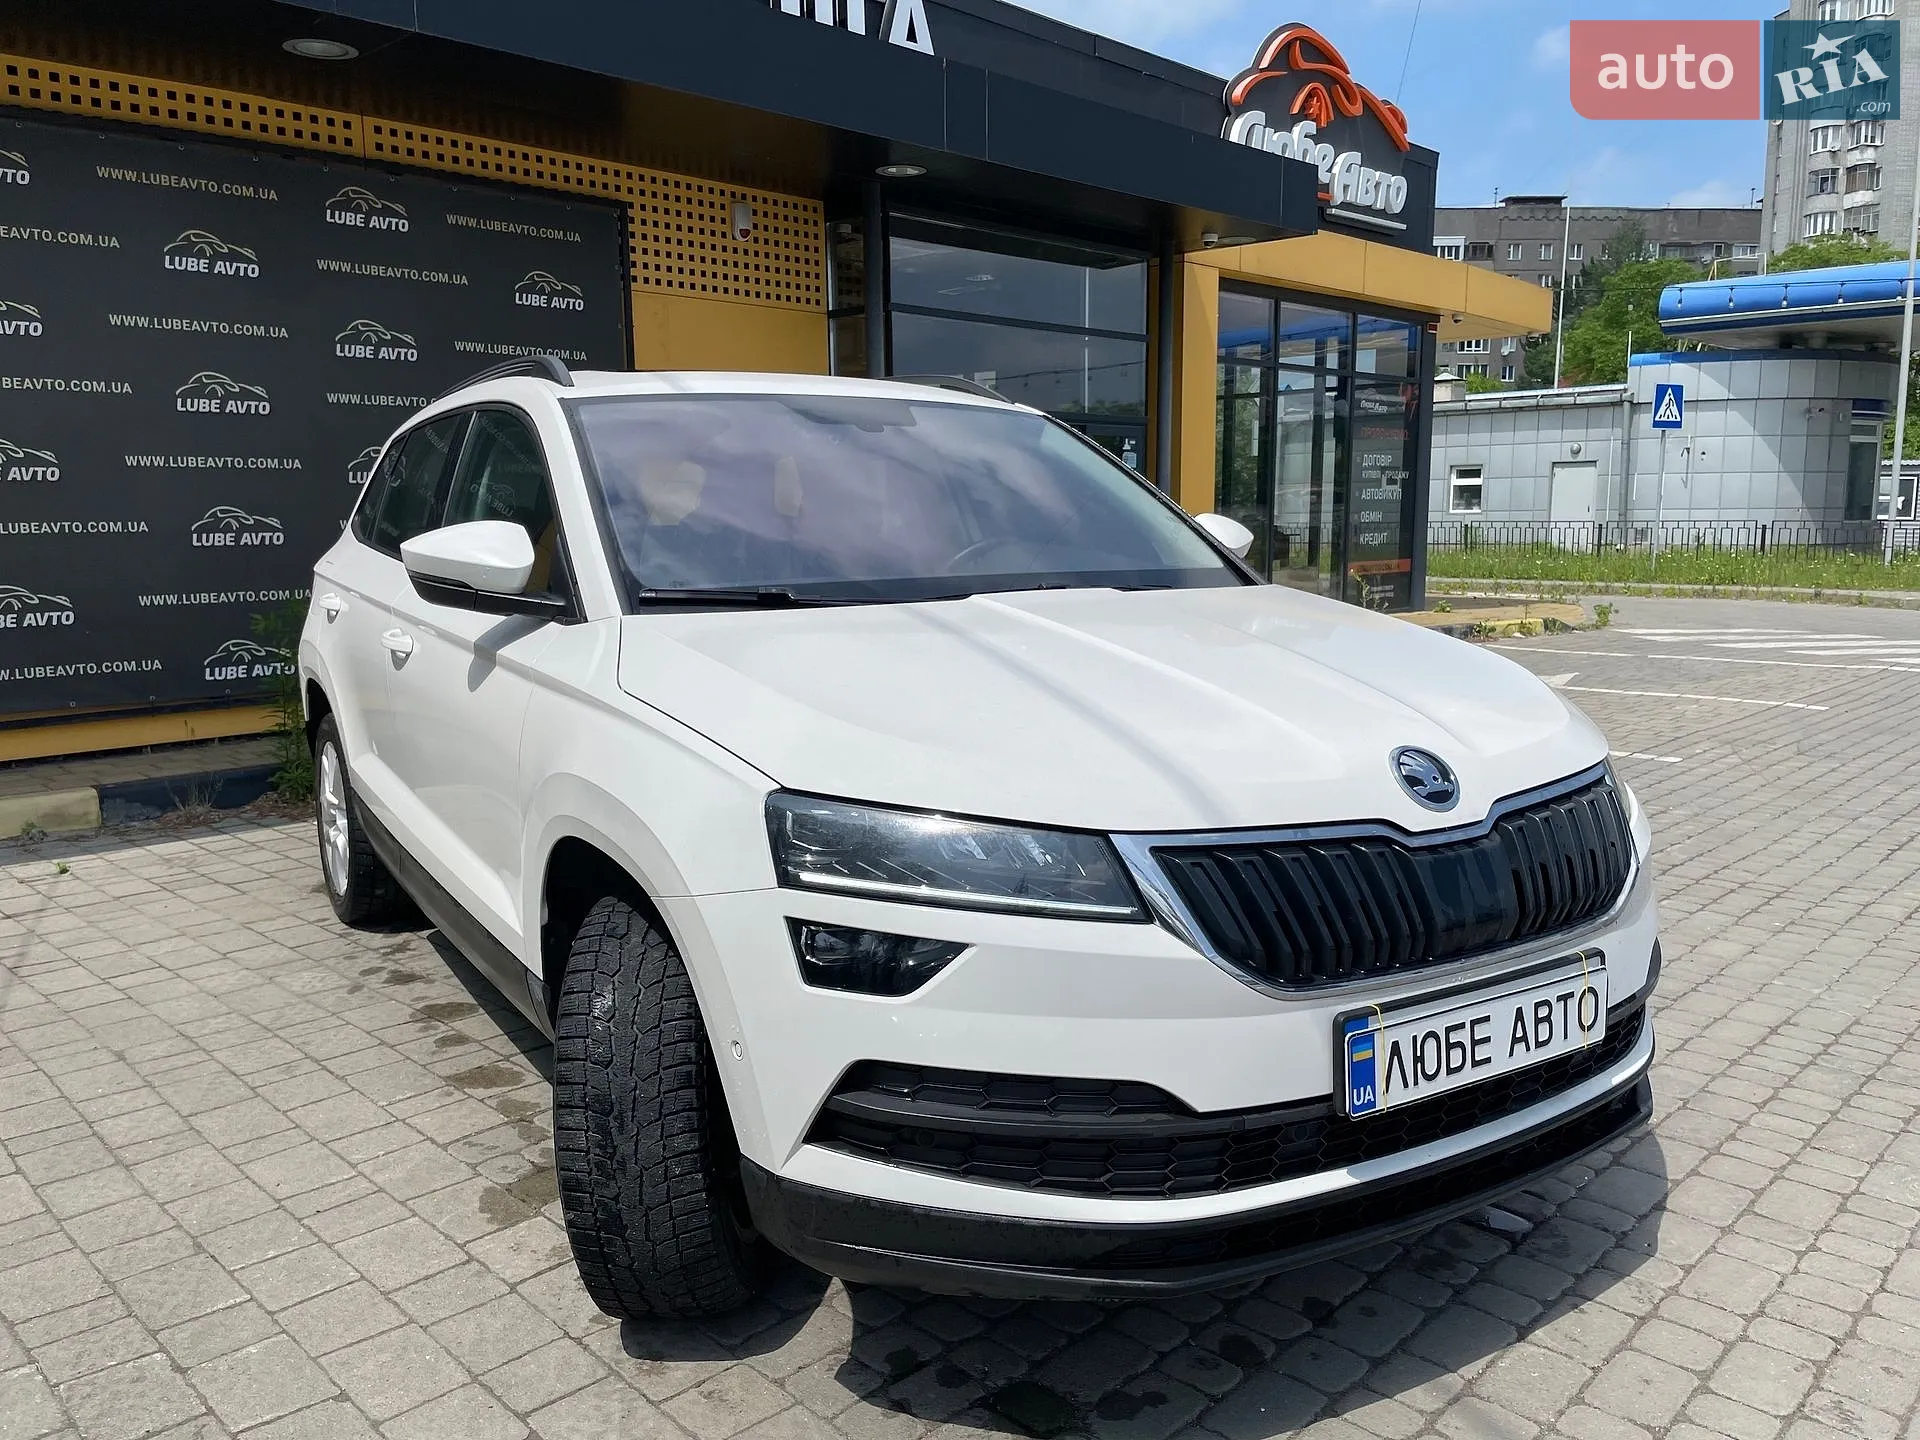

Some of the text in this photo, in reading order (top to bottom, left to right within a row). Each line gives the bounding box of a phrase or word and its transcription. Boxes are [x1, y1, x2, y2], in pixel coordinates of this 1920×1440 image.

[96, 165, 278, 200] WWW.LUBEAVTO.COM.UA
[326, 208, 409, 232] LUBE AVTO
[446, 214, 582, 243] WWW.LUBEAVTO.COM.UA
[164, 255, 260, 278] LUBE AVTO
[316, 259, 469, 286] WWW.LUBEAVTO.COM.UA
[515, 292, 585, 311] LUBE AVTO
[109, 314, 289, 338] WWW.LUBEAVTO.COM.UA
[335, 343, 418, 361] LUBE AVTO
[454, 341, 587, 361] WWW.LUBEAVTOCOM.UA
[2, 377, 133, 394] BEAVTO.COM.UA
[176, 398, 271, 415] LUBE AVTO
[125, 455, 302, 470] WWW.LUBEAVTO.COM.UA
[7, 467, 60, 481] AVTO
[192, 532, 285, 547] LUBE AVTO
[139, 589, 312, 606] WWW.LUBEAVTO.COMUA
[23, 611, 75, 627] AVTO
[205, 663, 296, 680] LUBE AVTO
[1383, 986, 1600, 1094] ЛЮБЕ АВТО
[1353, 1088, 1375, 1105] UA
